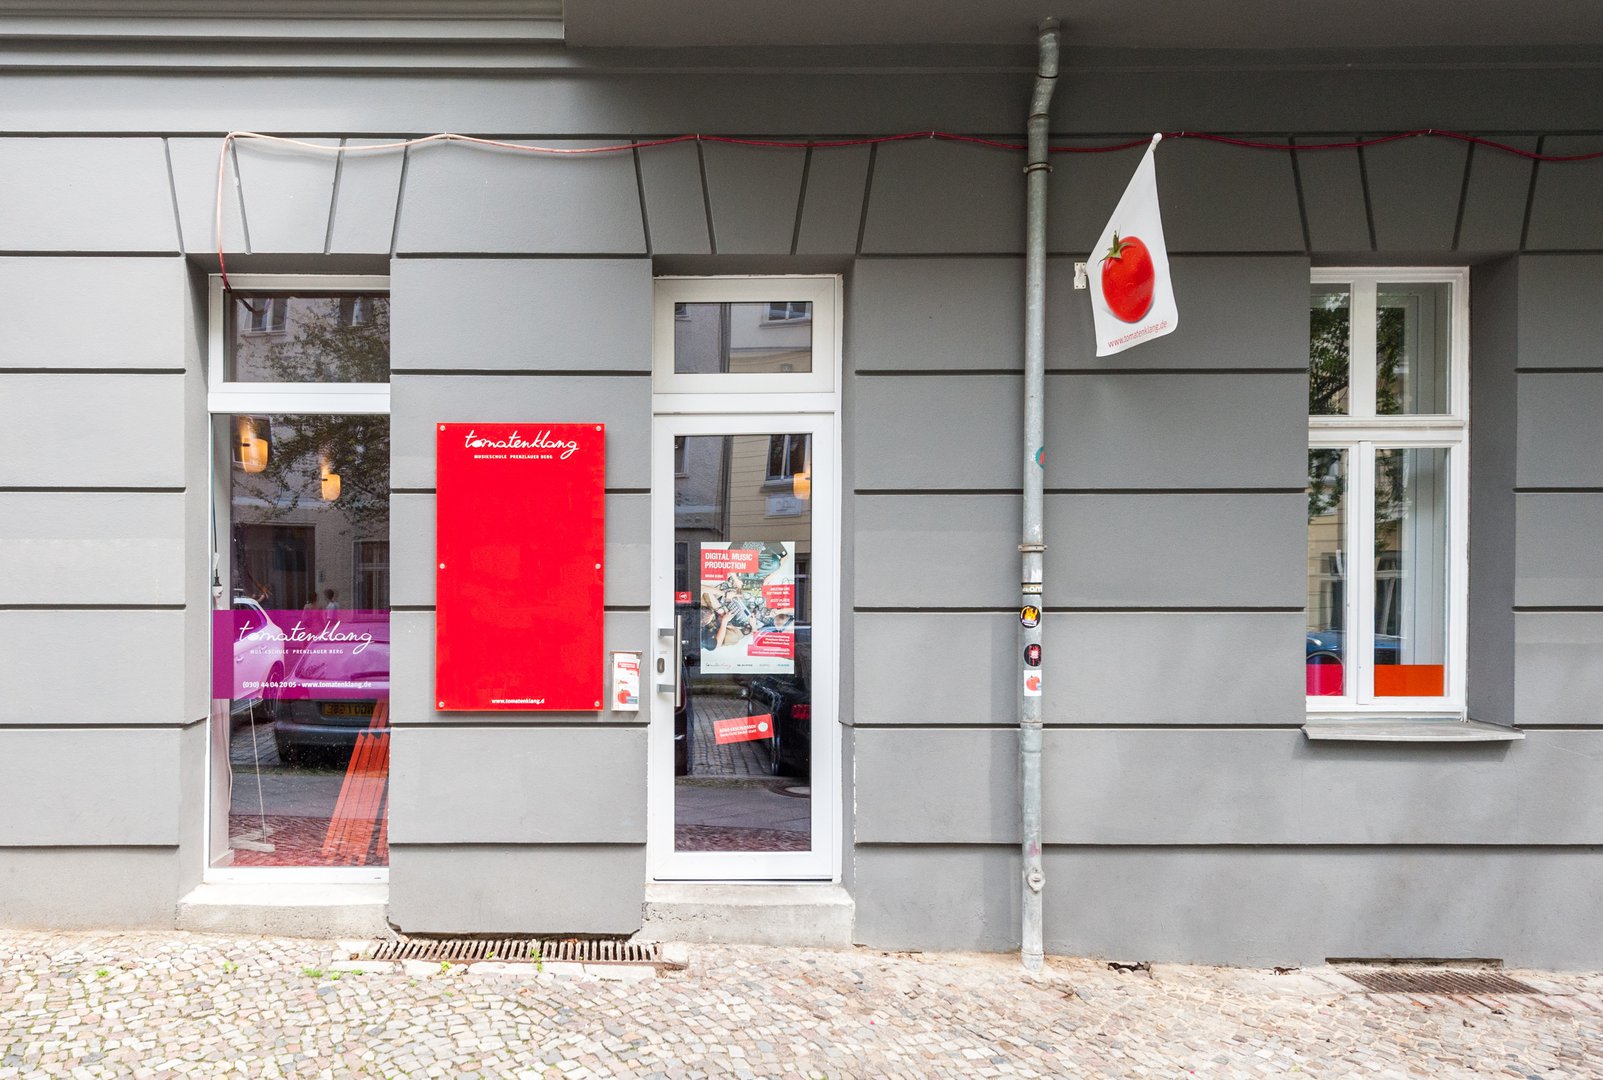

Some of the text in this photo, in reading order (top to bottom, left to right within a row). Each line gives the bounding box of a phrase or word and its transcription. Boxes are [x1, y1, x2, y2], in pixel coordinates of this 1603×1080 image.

[464, 429, 580, 460] tomatenklang
[705, 552, 753, 561] DIGITAL MUSIC
[704, 561, 747, 570] PRODUCTION
[239, 620, 375, 655] tomatenklang
[242, 681, 260, 689] (030)
[301, 681, 372, 690] www.tomatenklang.de
